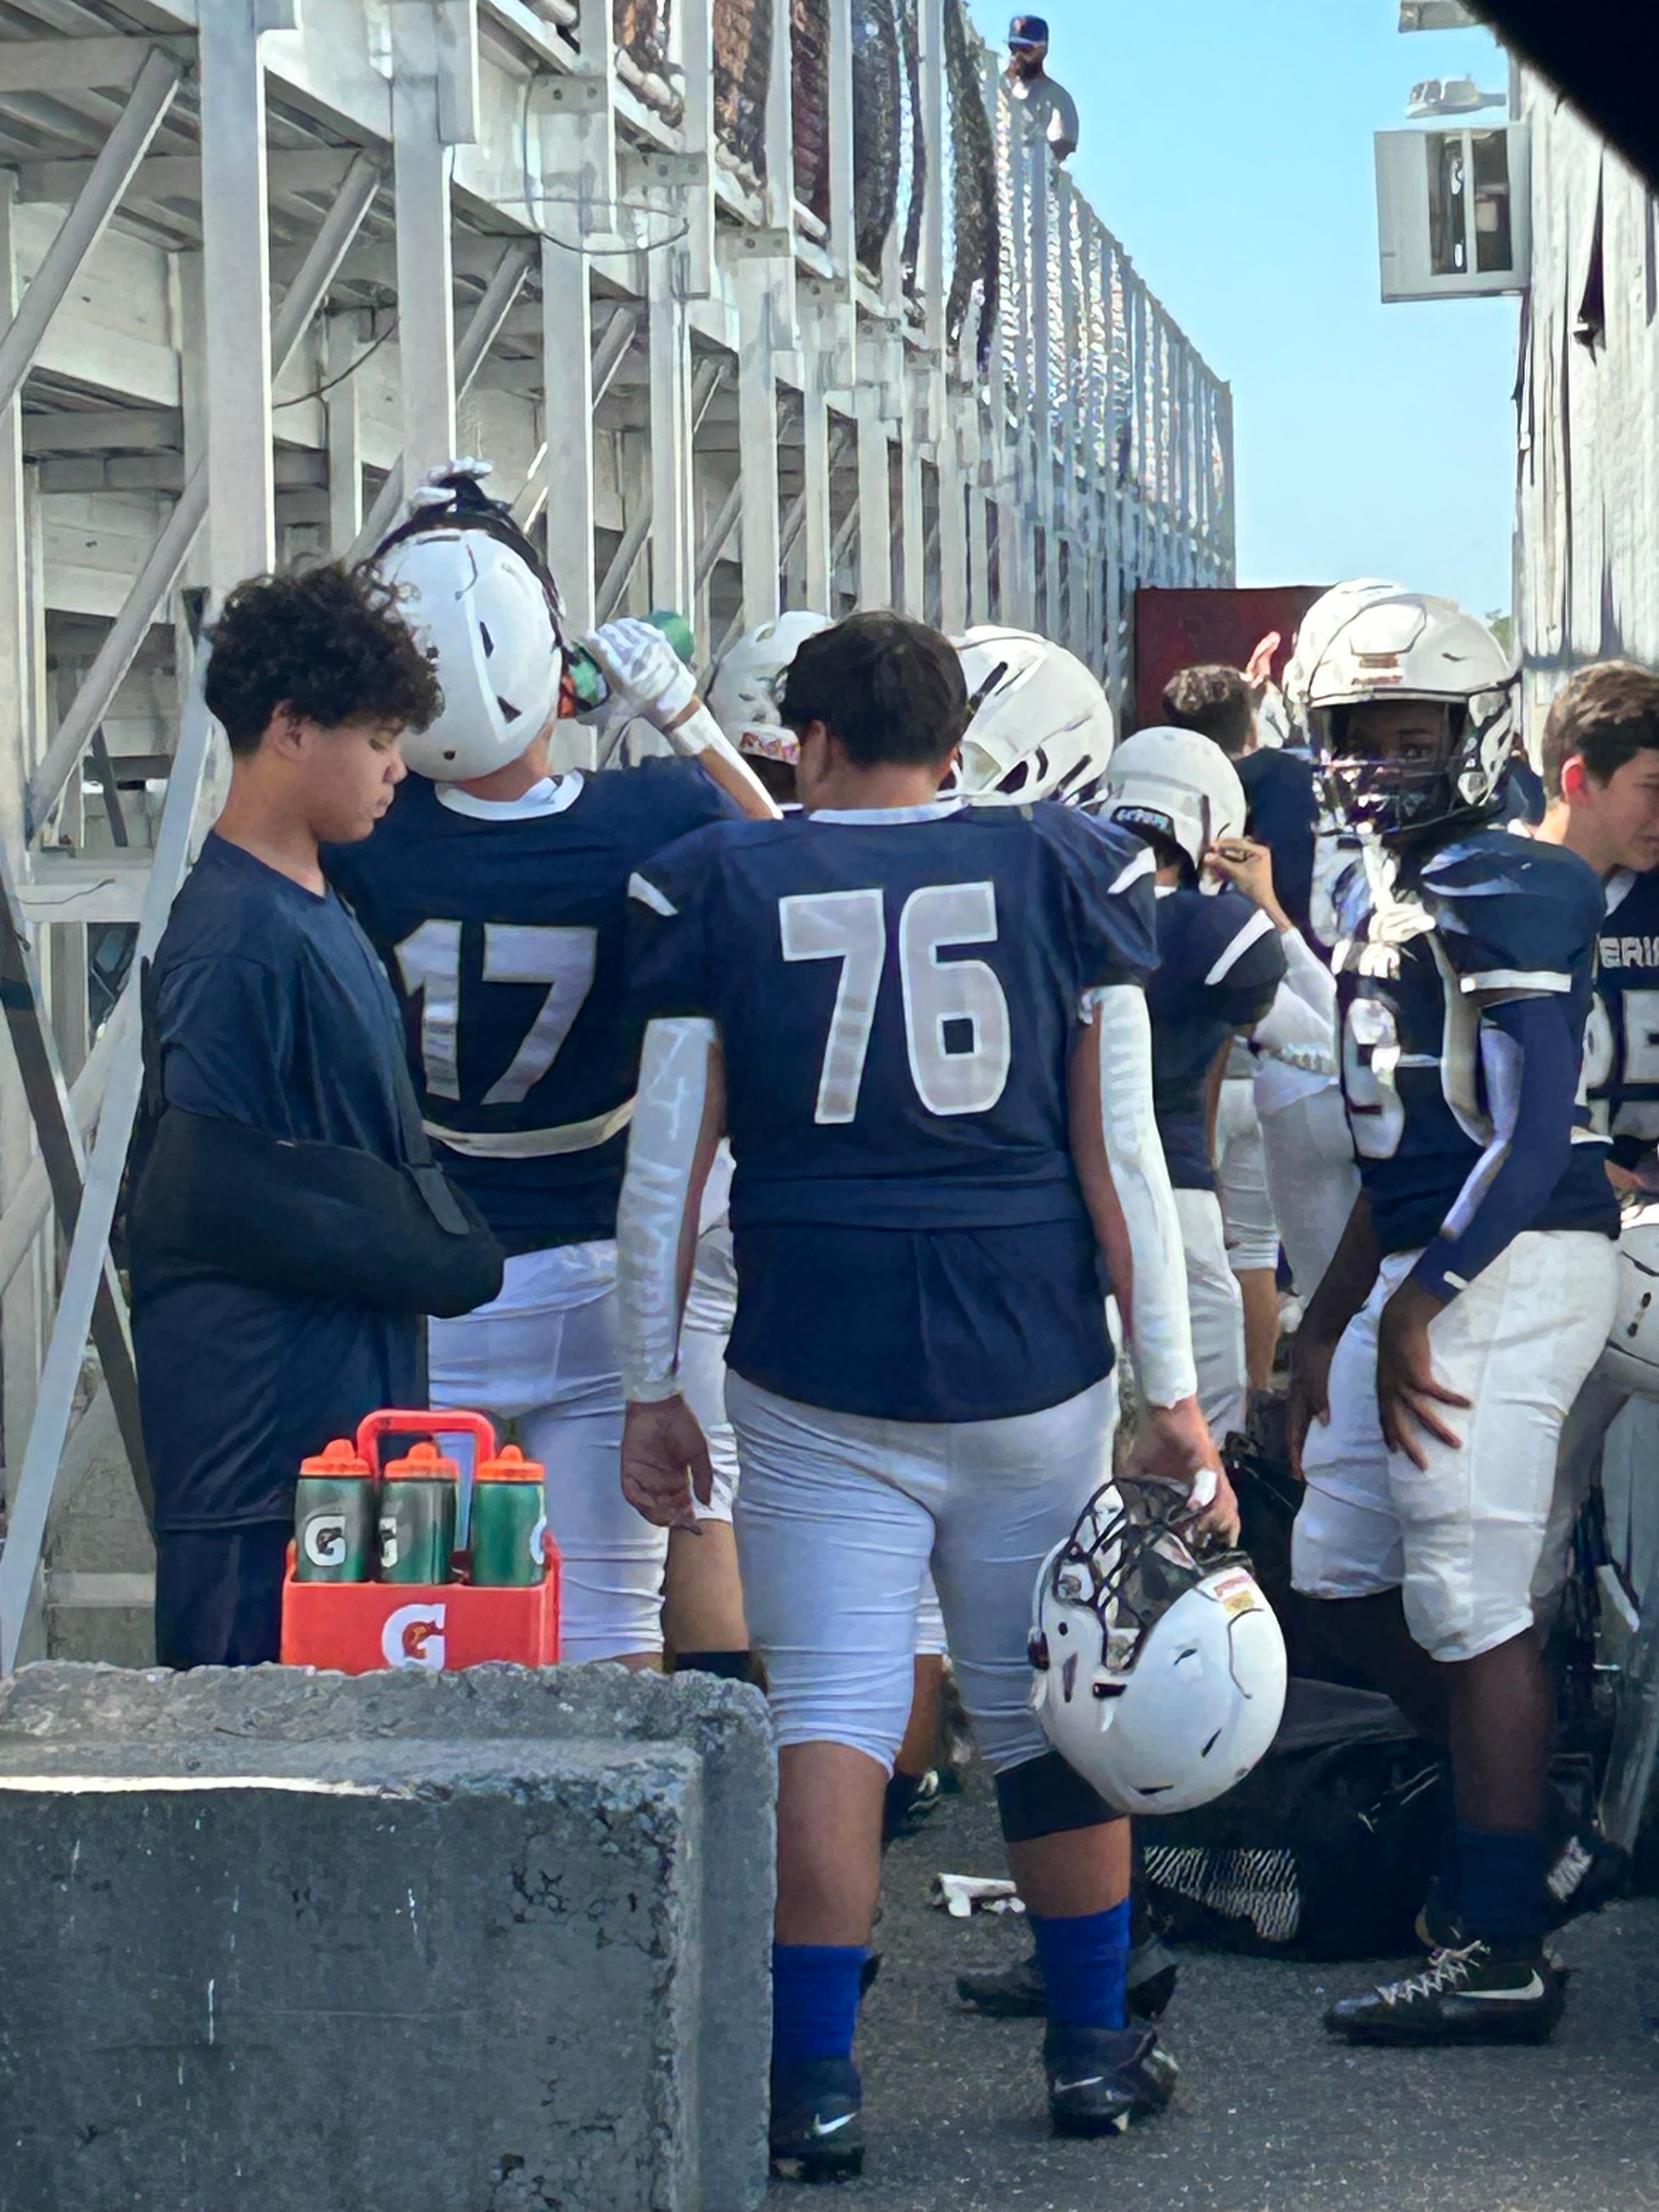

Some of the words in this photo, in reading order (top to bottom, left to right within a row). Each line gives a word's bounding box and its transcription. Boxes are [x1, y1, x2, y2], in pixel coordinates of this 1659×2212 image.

[393, 918, 599, 1106] 17
[778, 881, 1012, 1124] 76
[304, 1516, 346, 1567] G
[382, 1603, 446, 1671] G
